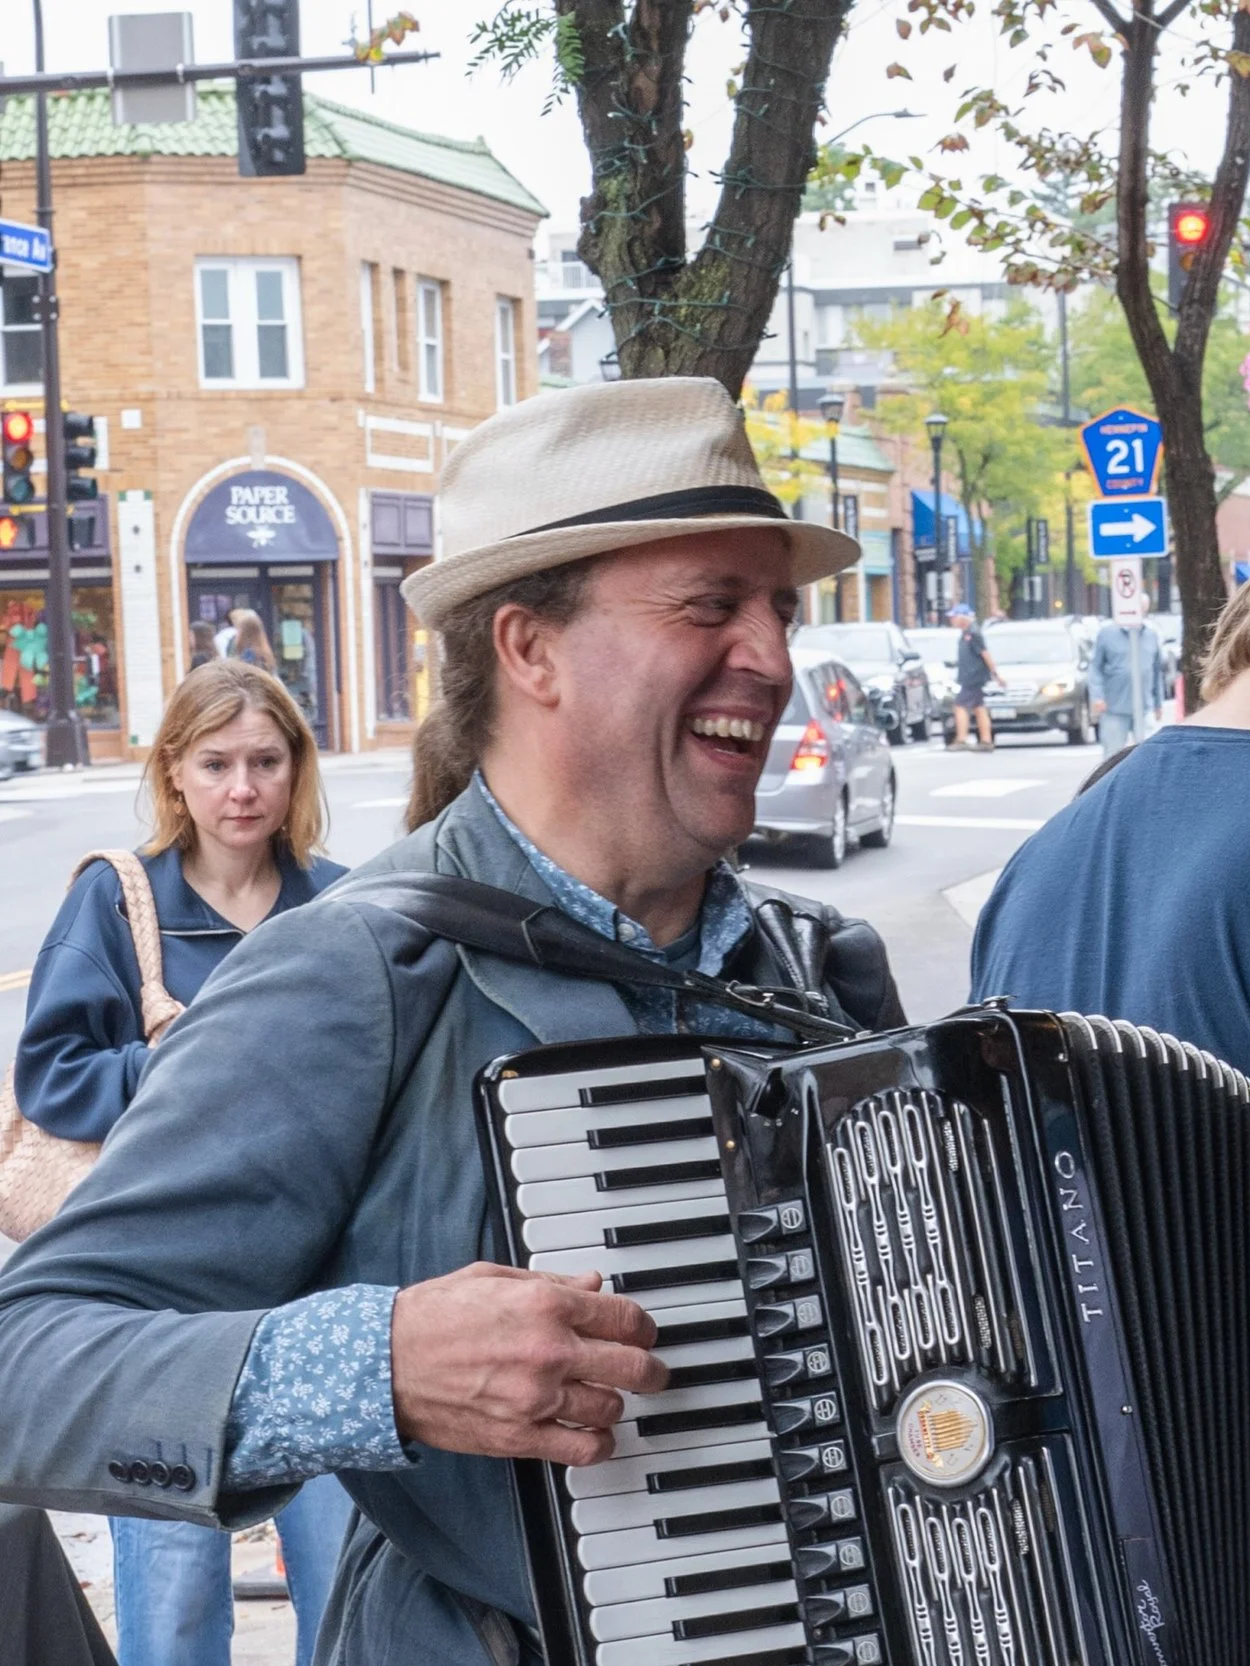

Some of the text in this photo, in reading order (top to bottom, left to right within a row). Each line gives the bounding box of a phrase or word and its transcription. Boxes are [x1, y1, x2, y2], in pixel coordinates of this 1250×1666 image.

[1105, 438, 1144, 474] 21
[230, 485, 290, 506] PAPER
[225, 504, 297, 525] SOURCE
[1054, 1150, 1104, 1323] TITANO
[1136, 1579, 1165, 1629] Royal
